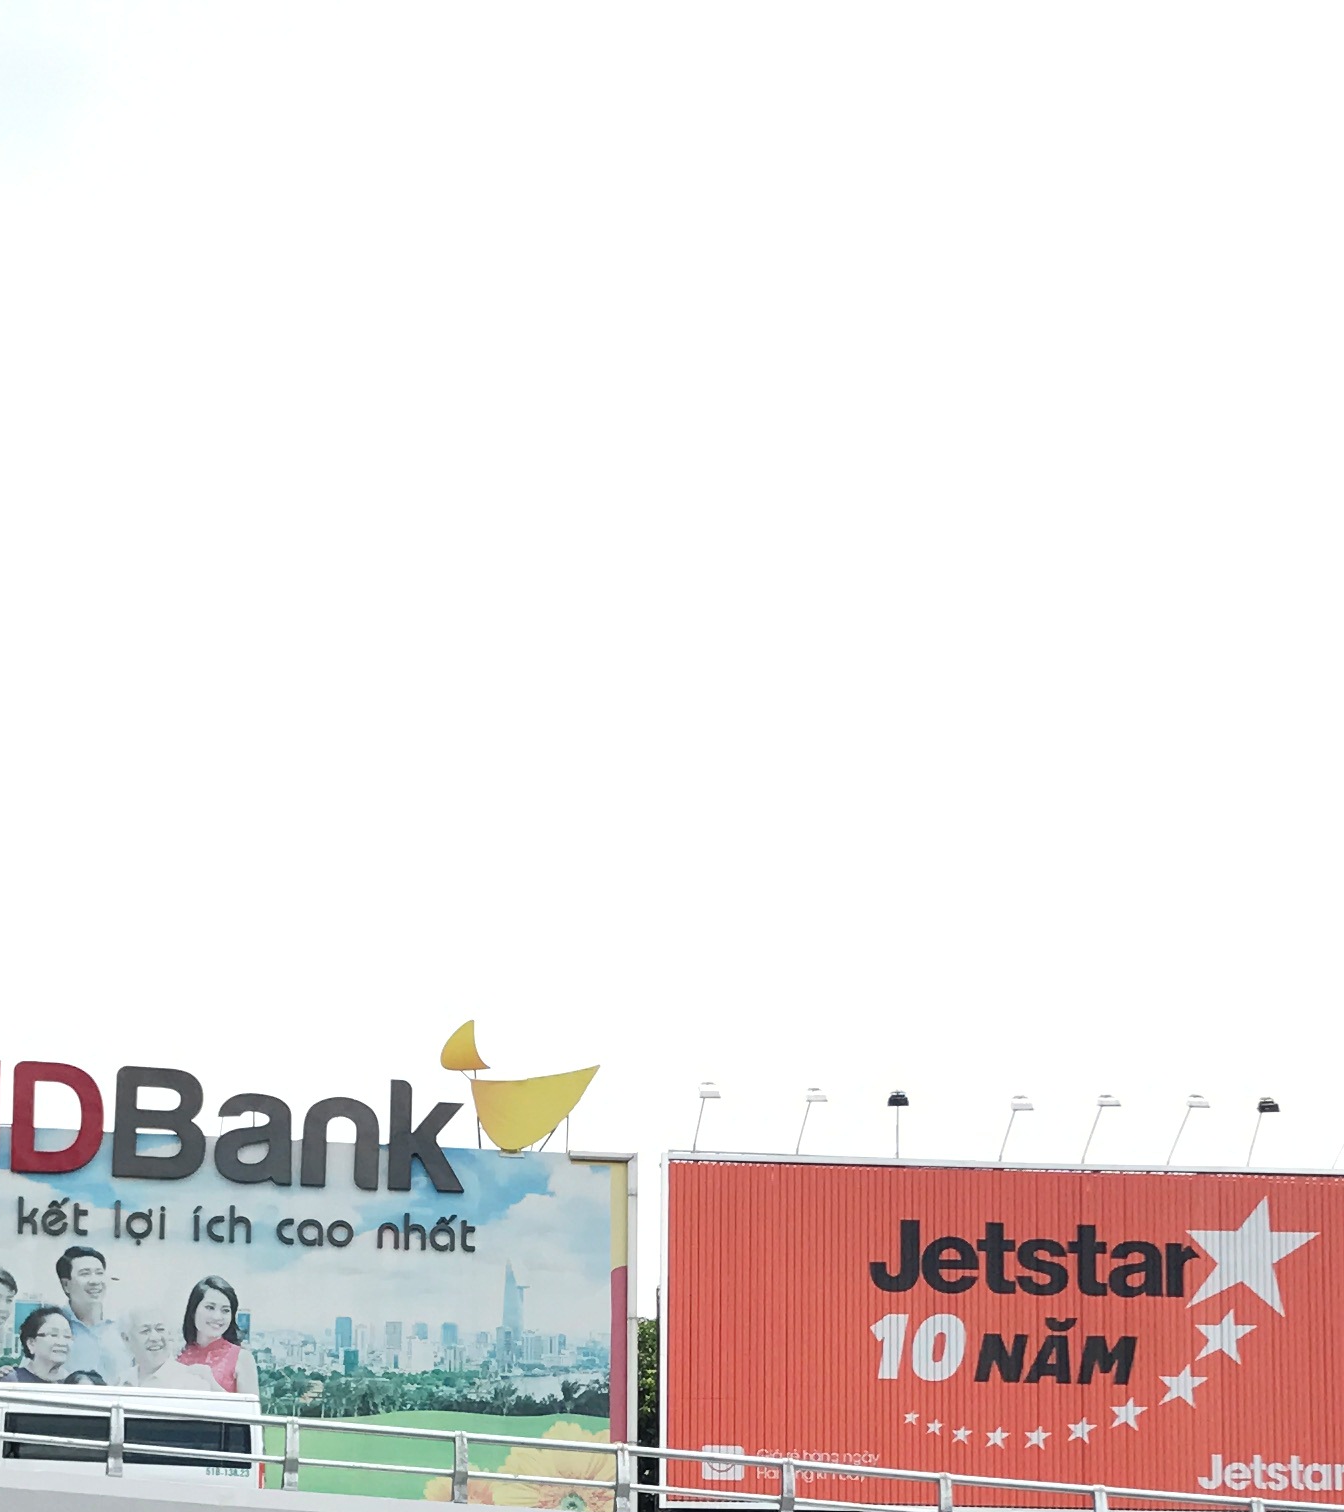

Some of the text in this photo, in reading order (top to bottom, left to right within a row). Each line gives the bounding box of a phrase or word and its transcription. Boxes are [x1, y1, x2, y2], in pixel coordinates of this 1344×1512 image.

[17, 1196, 88, 1237] kết
[113, 1199, 167, 1247] lợi
[192, 1204, 252, 1245] ích
[276, 1216, 354, 1249] cao
[376, 1212, 477, 1254] nhất
[869, 1218, 1200, 1298] Jetstar
[870, 1312, 1138, 1386] 10 NĂM
